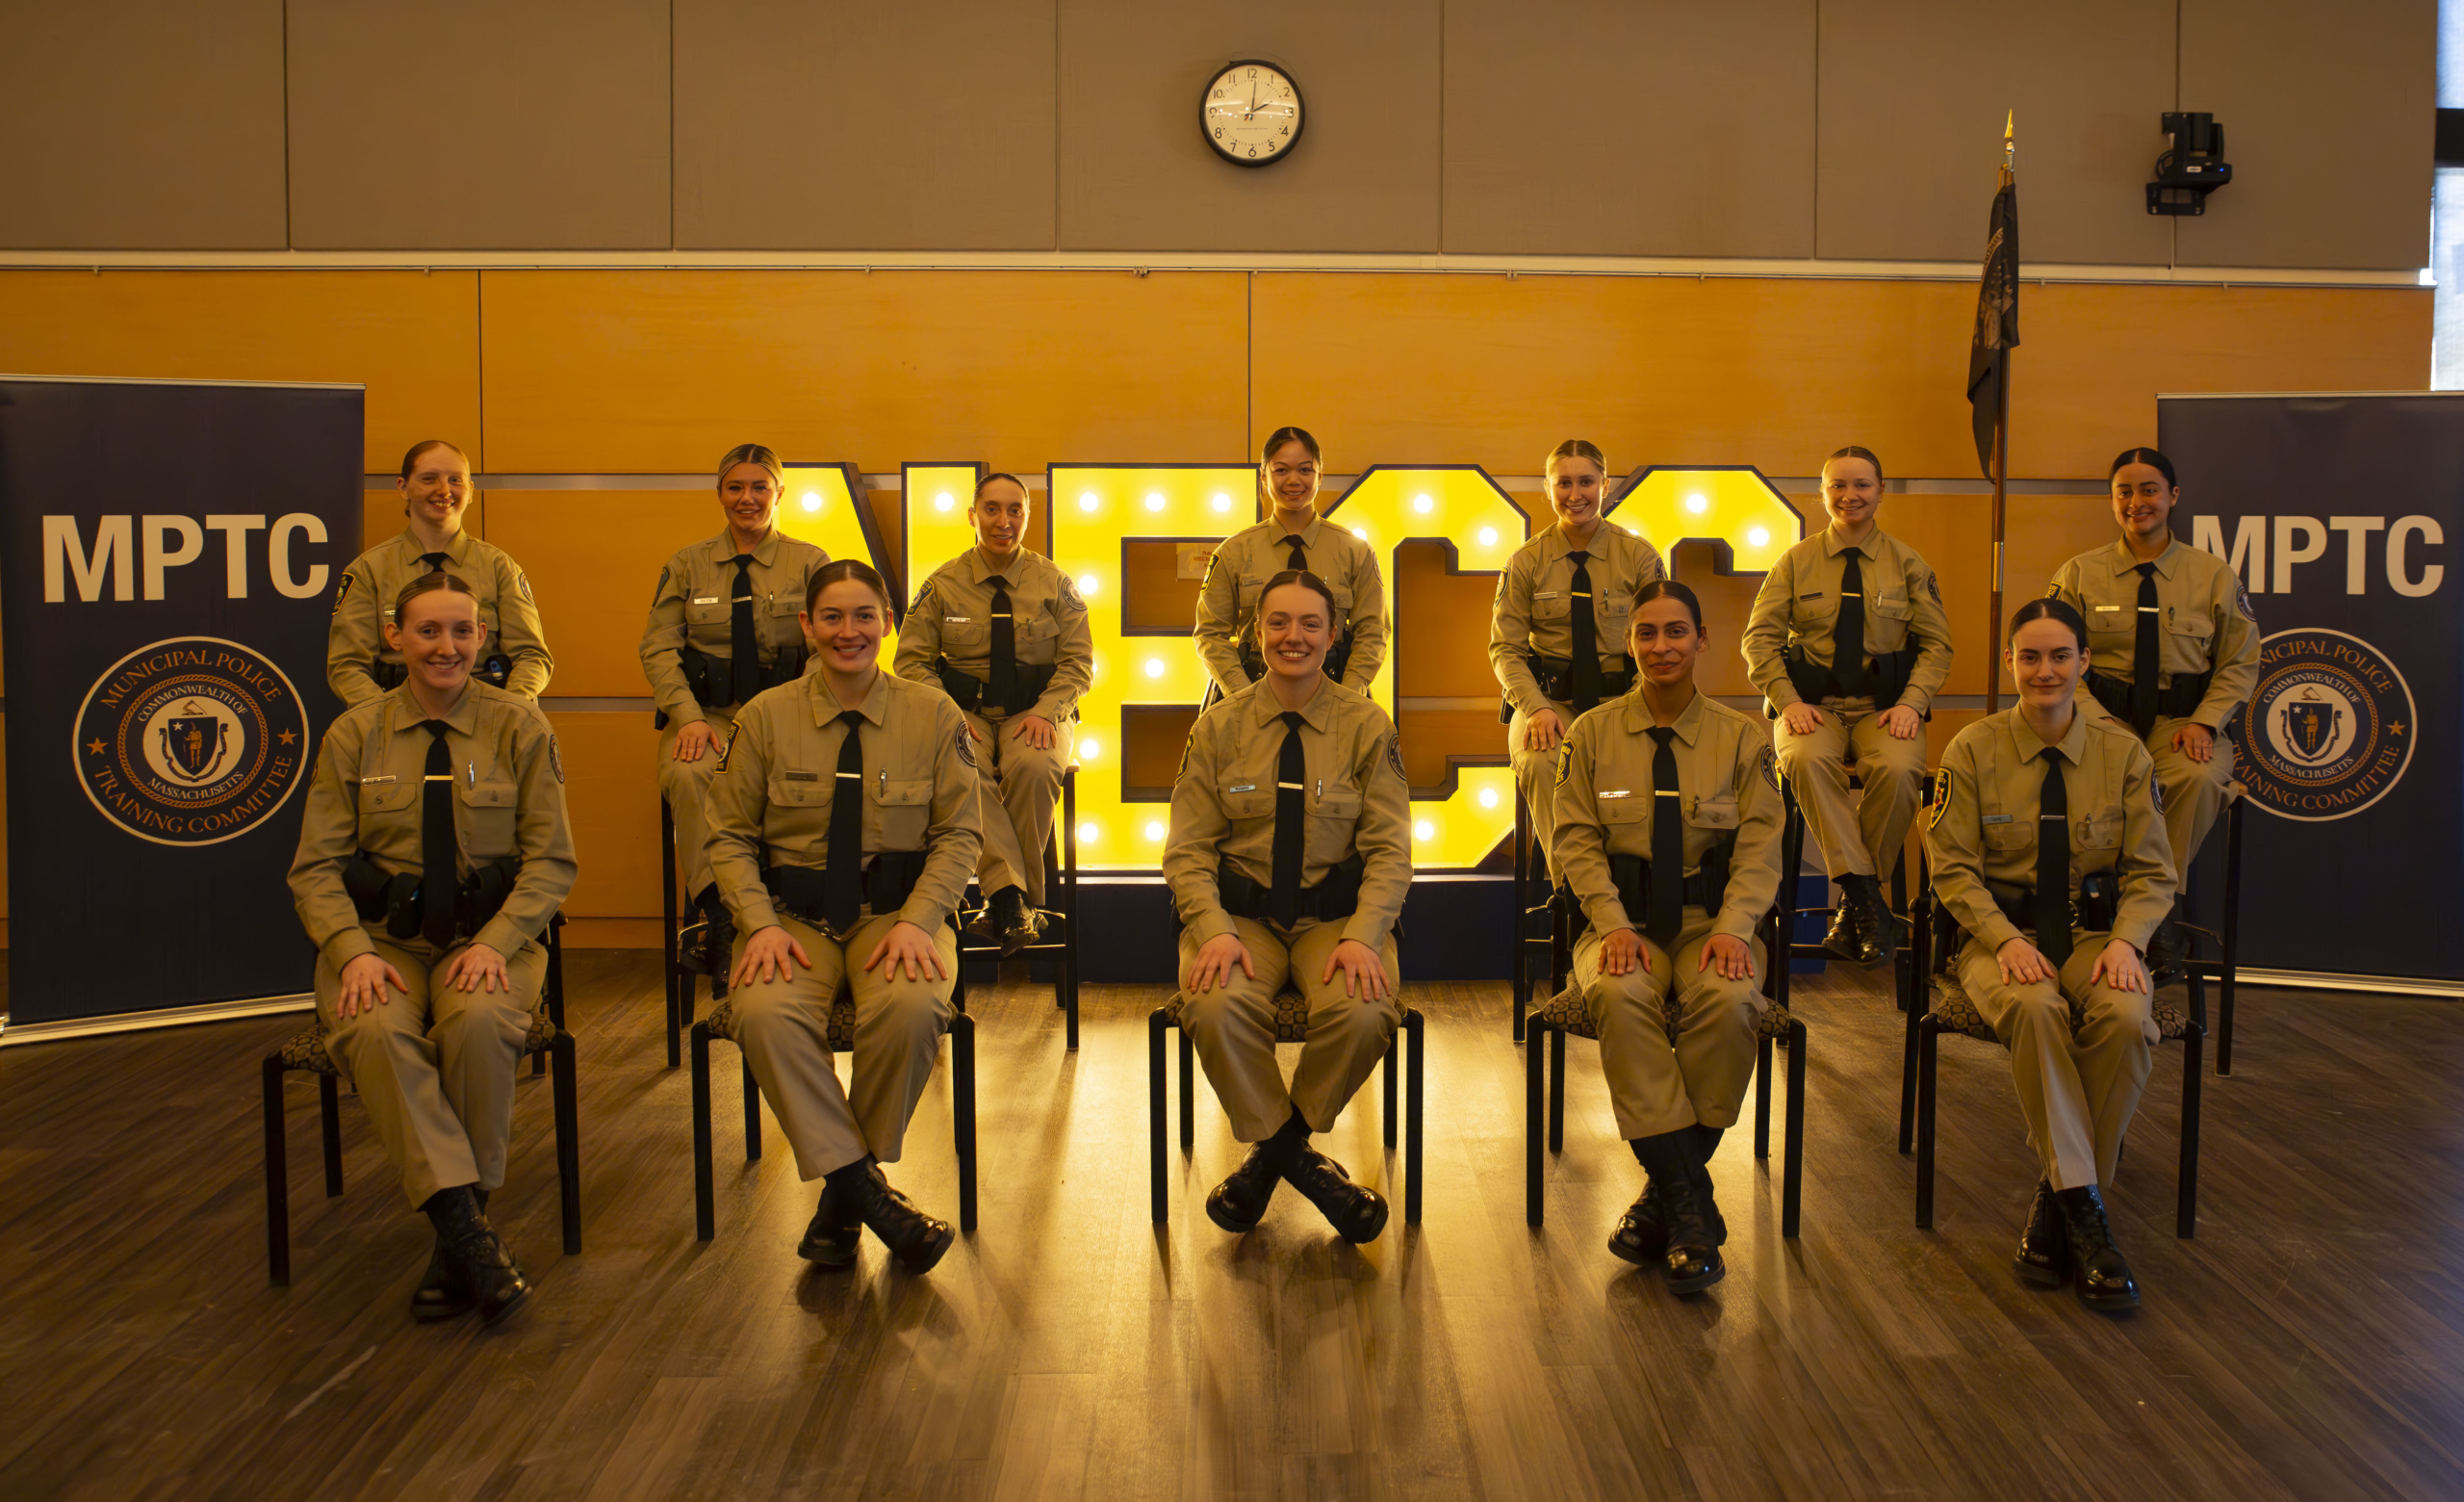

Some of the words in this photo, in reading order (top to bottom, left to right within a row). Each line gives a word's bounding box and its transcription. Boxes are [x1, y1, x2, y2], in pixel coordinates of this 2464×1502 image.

[1228, 73, 1236, 84] 11
[1247, 68, 1257, 79] 12
[1270, 73, 1274, 84] 1
[1213, 89, 1223, 99] 10
[1283, 87, 1291, 97] 2
[1287, 107, 1295, 118] 3
[1214, 127, 1222, 139] 8
[1280, 125, 1289, 137] 4
[1230, 142, 1237, 153] 7
[1247, 146, 1257, 158] 6
[1269, 142, 1275, 152] 5
[42, 512, 329, 603] MPTC
[2193, 514, 2445, 598] MPTC
[2259, 640, 2331, 668] NICIPAL
[2333, 644, 2394, 694] POLICE
[100, 649, 213, 710] MUNICIPAL
[216, 652, 282, 702] POLICE
[2263, 672, 2349, 704] COMMONWEALTH
[138, 685, 236, 722] COMMONWEALTH
[233, 701, 248, 714] OF
[2269, 754, 2355, 778] MASSACHUSETTS
[2301, 744, 2400, 810] COMMITTEE
[146, 771, 244, 800] MASSACHUSETTS
[95, 765, 183, 833] TRAINING
[188, 755, 292, 834] COMMITTEE
